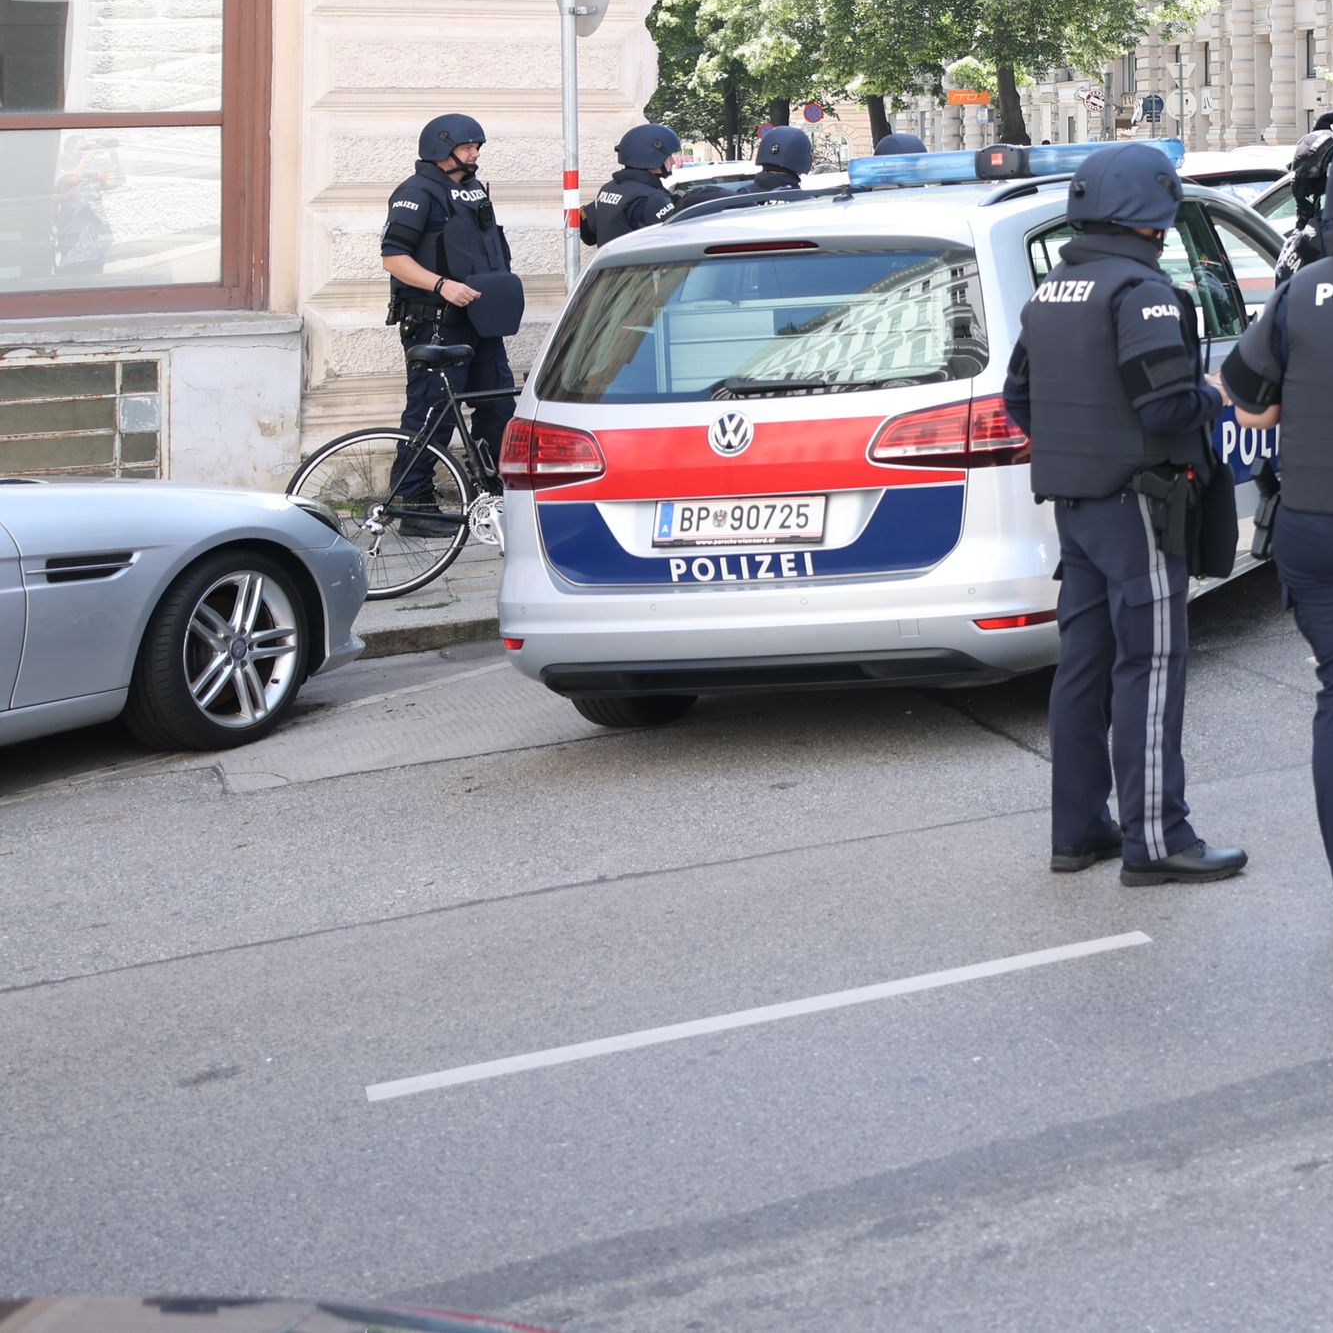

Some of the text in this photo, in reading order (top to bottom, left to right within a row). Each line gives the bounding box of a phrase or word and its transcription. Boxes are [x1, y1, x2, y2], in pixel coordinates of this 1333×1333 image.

[392, 199, 419, 211] POLIZEI
[451, 188, 488, 202] POLIZEI
[1222, 420, 1280, 466] POLI
[679, 503, 810, 533] BP 90725
[669, 552, 814, 582] POLIZEI
